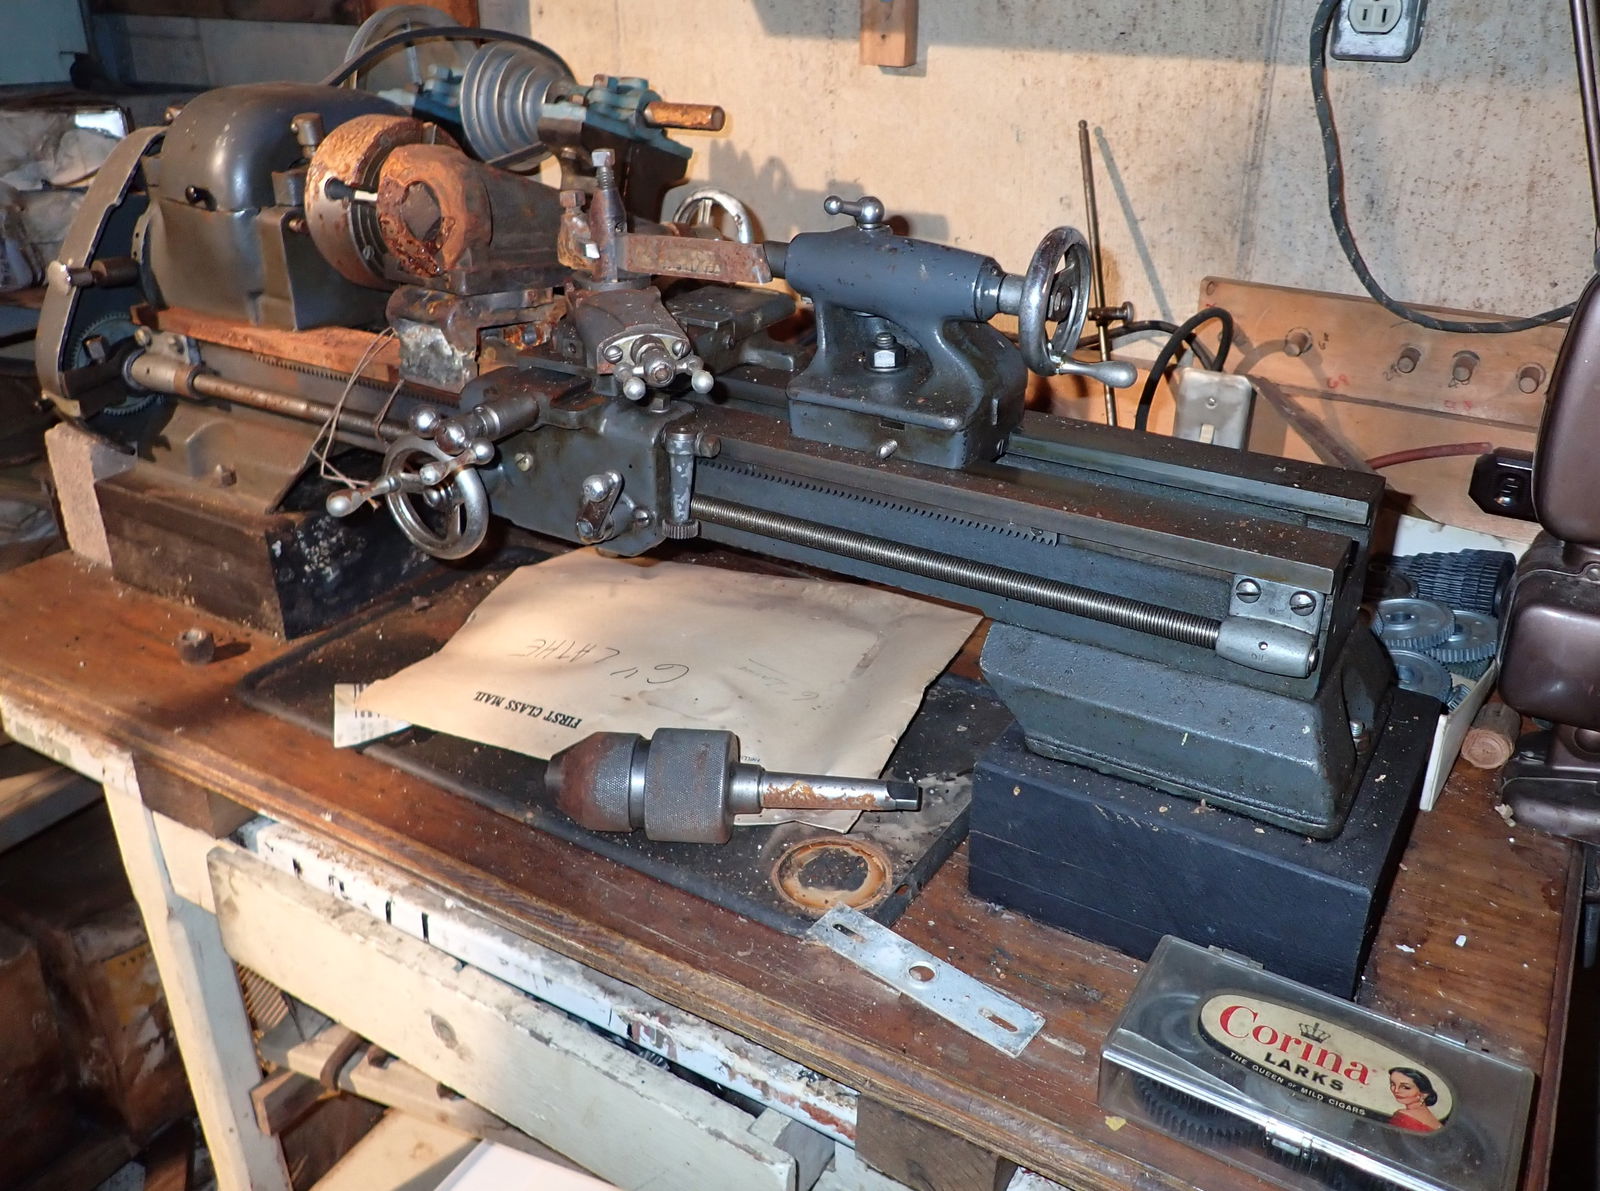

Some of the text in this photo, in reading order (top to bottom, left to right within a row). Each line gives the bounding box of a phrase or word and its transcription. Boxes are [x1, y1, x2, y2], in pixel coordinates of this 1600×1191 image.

[473, 690, 583, 729] FIRST CLASS MAIL
[1219, 1005, 1371, 1086] Corina
[1229, 1052, 1249, 1065] THE
[1252, 1064, 1285, 1084] QUEEN
[1300, 1087, 1324, 1101] MILD
[1328, 1098, 1367, 1116] CIGARS
[1264, 1052, 1345, 1092] LARKS
